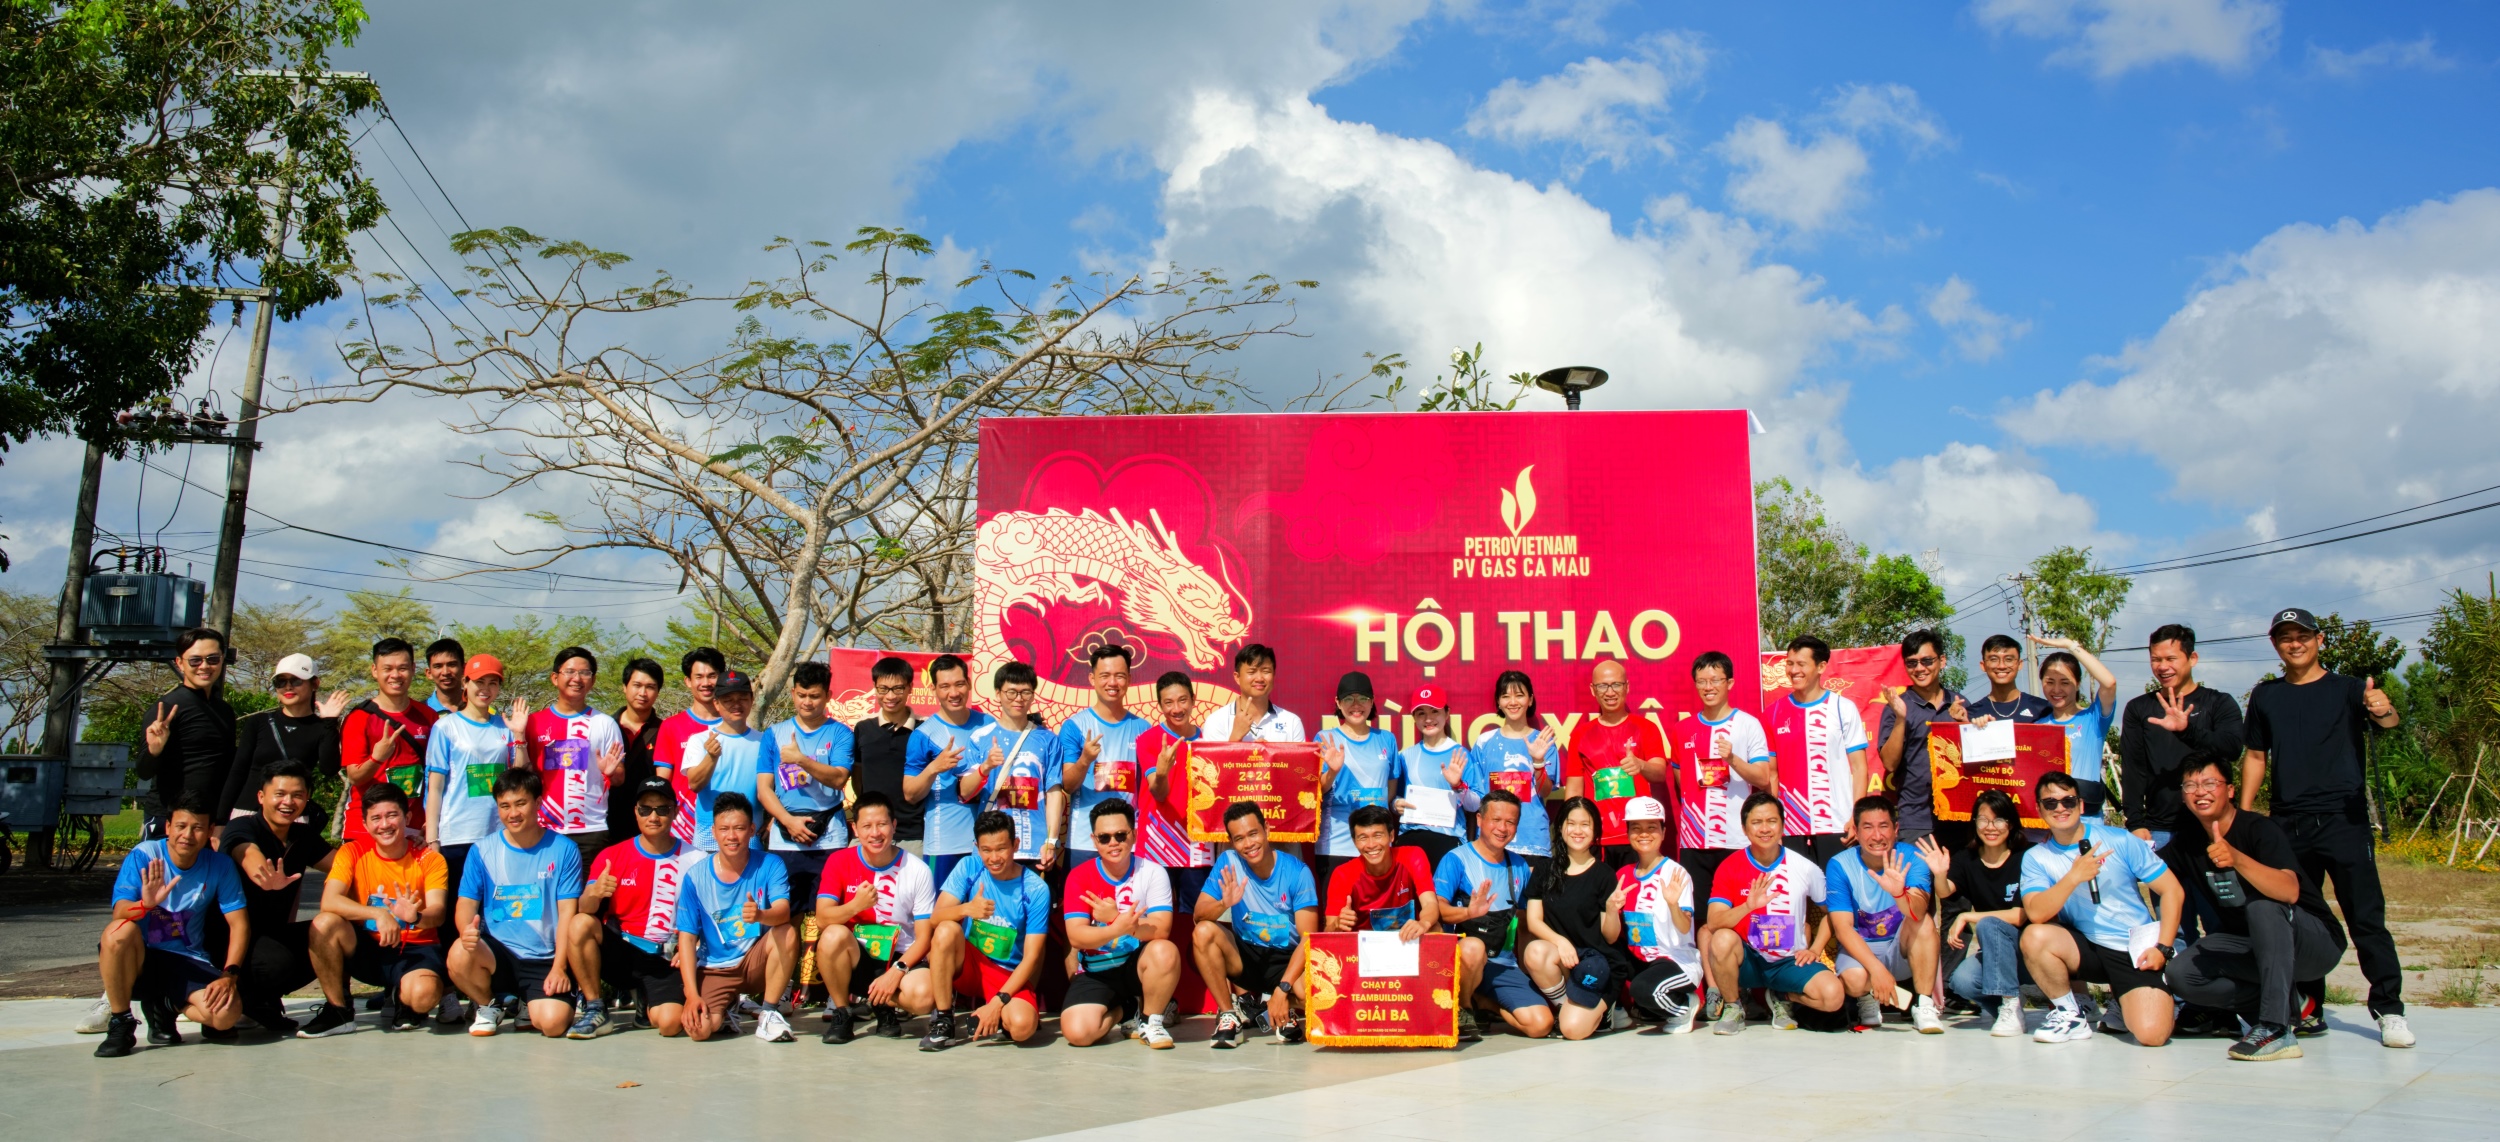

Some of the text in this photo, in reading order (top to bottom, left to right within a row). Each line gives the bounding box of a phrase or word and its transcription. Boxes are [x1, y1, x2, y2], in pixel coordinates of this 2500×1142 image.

[1464, 535, 1578, 557] PETROVIETNAM
[1453, 556, 1590, 578] PV GAS CA MAU
[1356, 597, 1681, 677] HỘI THAO
[1272, 761, 1289, 769] XUÂN
[1980, 765, 2014, 776] CHẠY BỘ
[788, 770, 807, 787] 10
[1108, 774, 1127, 790] 12
[1703, 771, 1715, 786] 5
[1971, 776, 2026, 787] TEAMBUILDING
[404, 780, 413, 796] 3
[1237, 783, 1273, 793] CHẠY BỘ
[1609, 781, 1620, 796] 2
[1009, 791, 1030, 807] 14
[1228, 795, 1283, 803] TEAMBUILDING
[511, 902, 523, 918] 2
[733, 921, 746, 938] 3
[1259, 928, 1271, 942] 6
[1632, 927, 1641, 943] 8
[1876, 923, 1887, 936] 8
[983, 937, 996, 954] 5
[1762, 930, 1780, 947] 11
[870, 940, 881, 957] 8
[1361, 979, 1401, 991] CHẠY BỘ
[1351, 994, 1414, 1002] TEAMBUILDING
[1355, 1005, 1410, 1022] GIẢI BA
